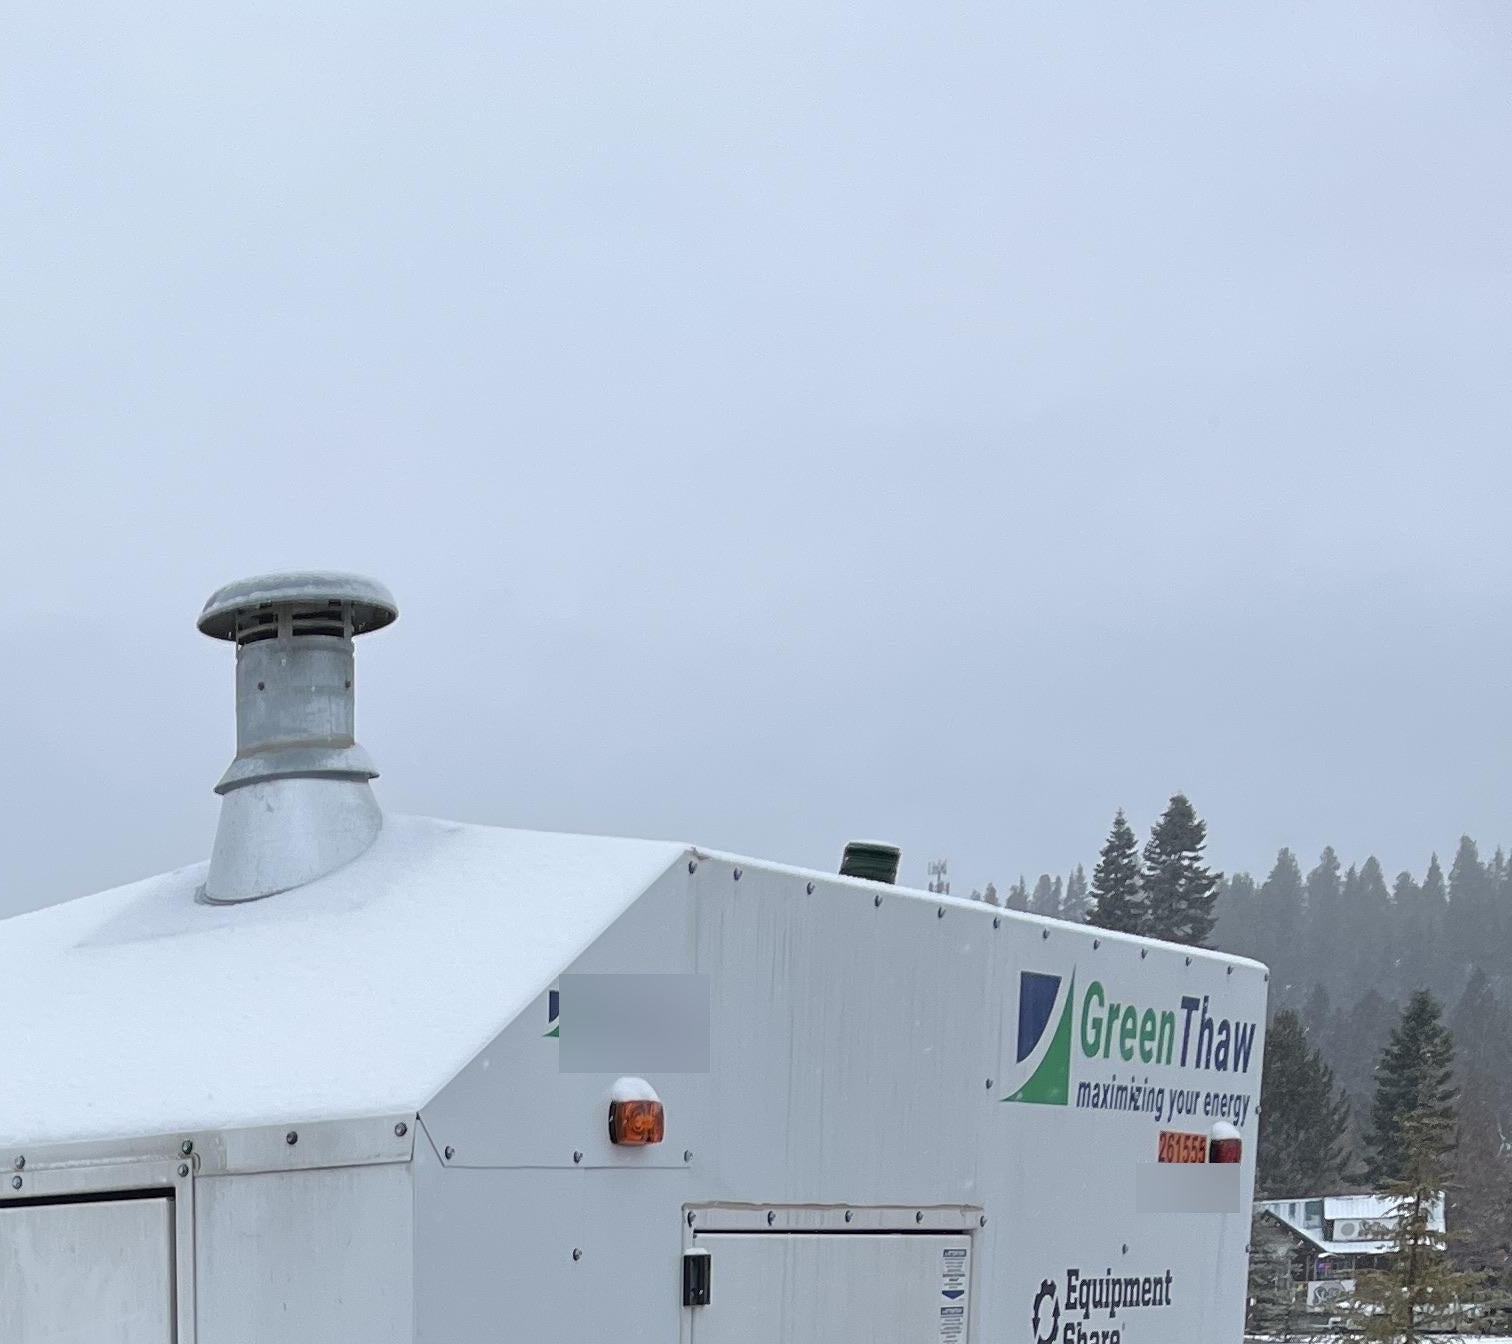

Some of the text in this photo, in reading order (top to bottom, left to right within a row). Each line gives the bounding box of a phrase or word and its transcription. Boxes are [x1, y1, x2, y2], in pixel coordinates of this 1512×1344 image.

[1076, 1074, 1251, 1127] maximizing your energy
[1158, 1131, 1207, 1164] 261555
[1065, 1267, 1173, 1320] Equipment
